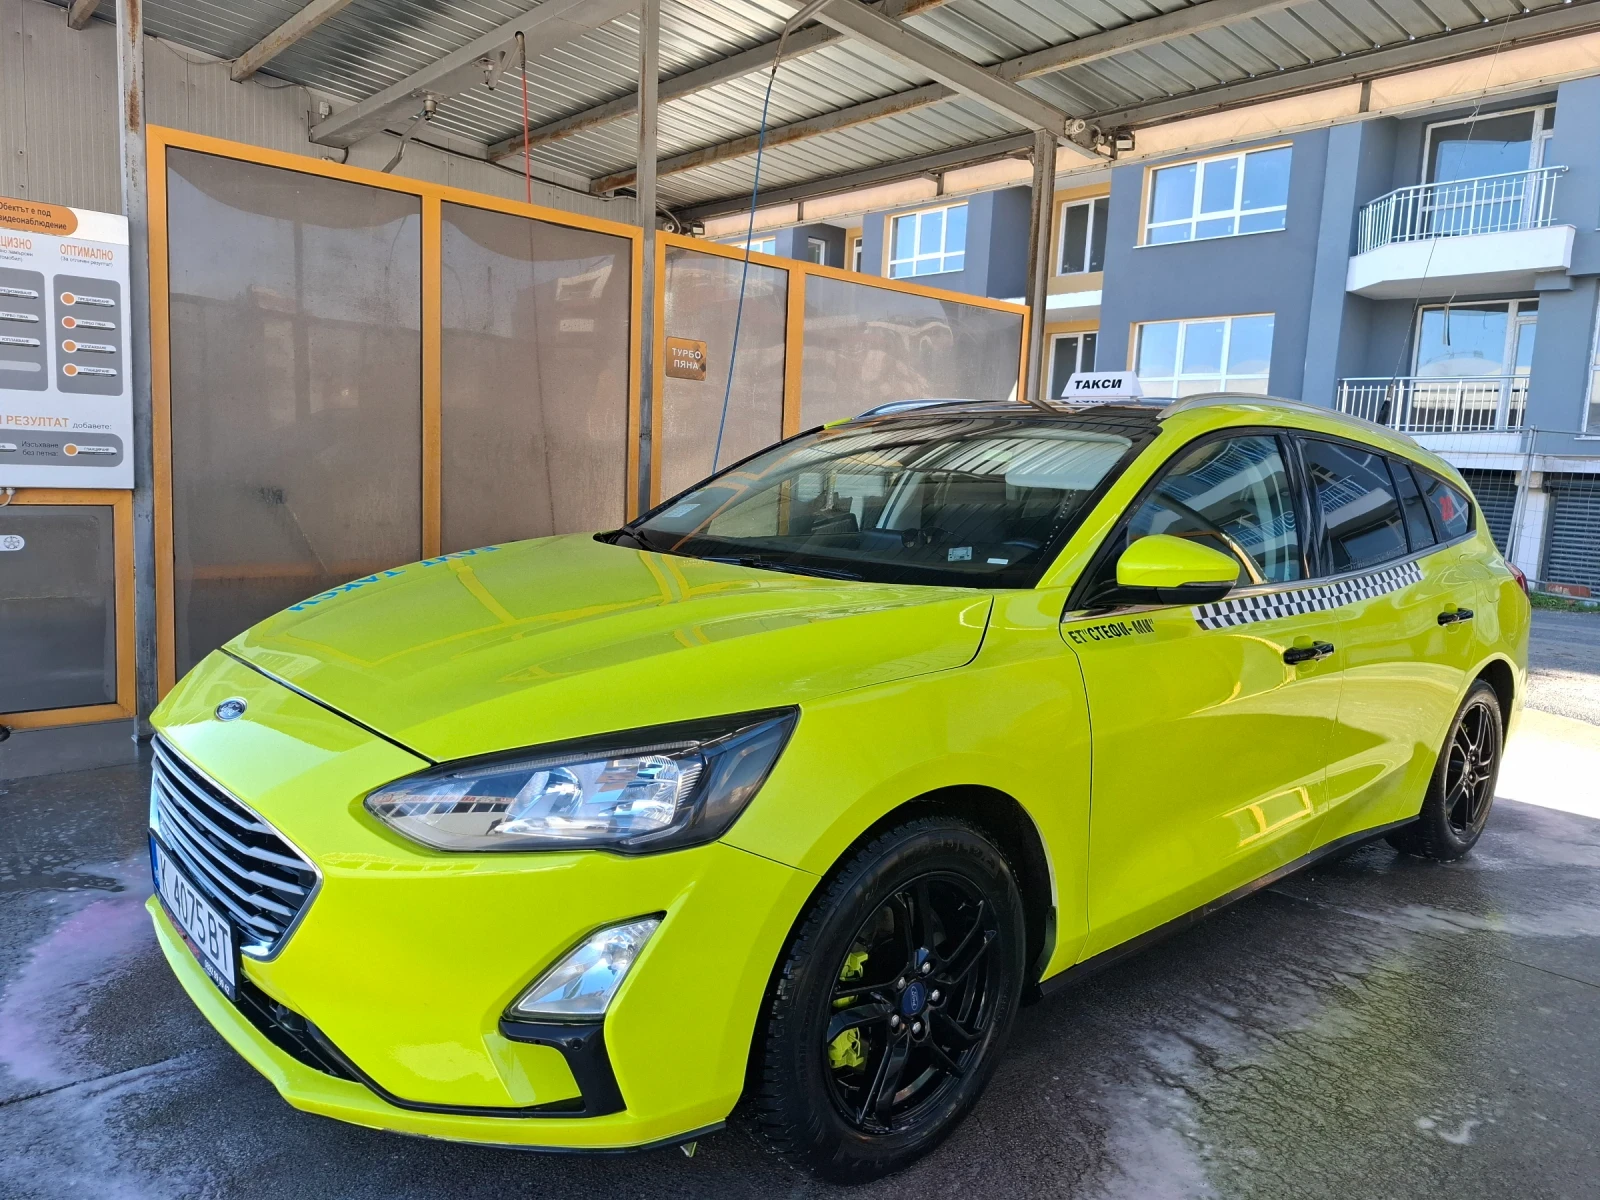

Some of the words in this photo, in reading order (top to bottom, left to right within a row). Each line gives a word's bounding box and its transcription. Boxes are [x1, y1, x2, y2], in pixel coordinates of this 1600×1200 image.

[37, 208, 52, 218] под
[60, 243, 114, 261] ОПТИМАЛНО
[672, 347, 702, 360] ТУРБО
[673, 359, 699, 370] ПЯНА
[1075, 378, 1122, 389] ТАКСИ
[6, 415, 69, 427] РЕЗУЛТАТ
[73, 421, 112, 430] добавете:
[21, 440, 59, 448] Изсъхване
[173, 874, 206, 945] 4075
[207, 910, 229, 971] BT
